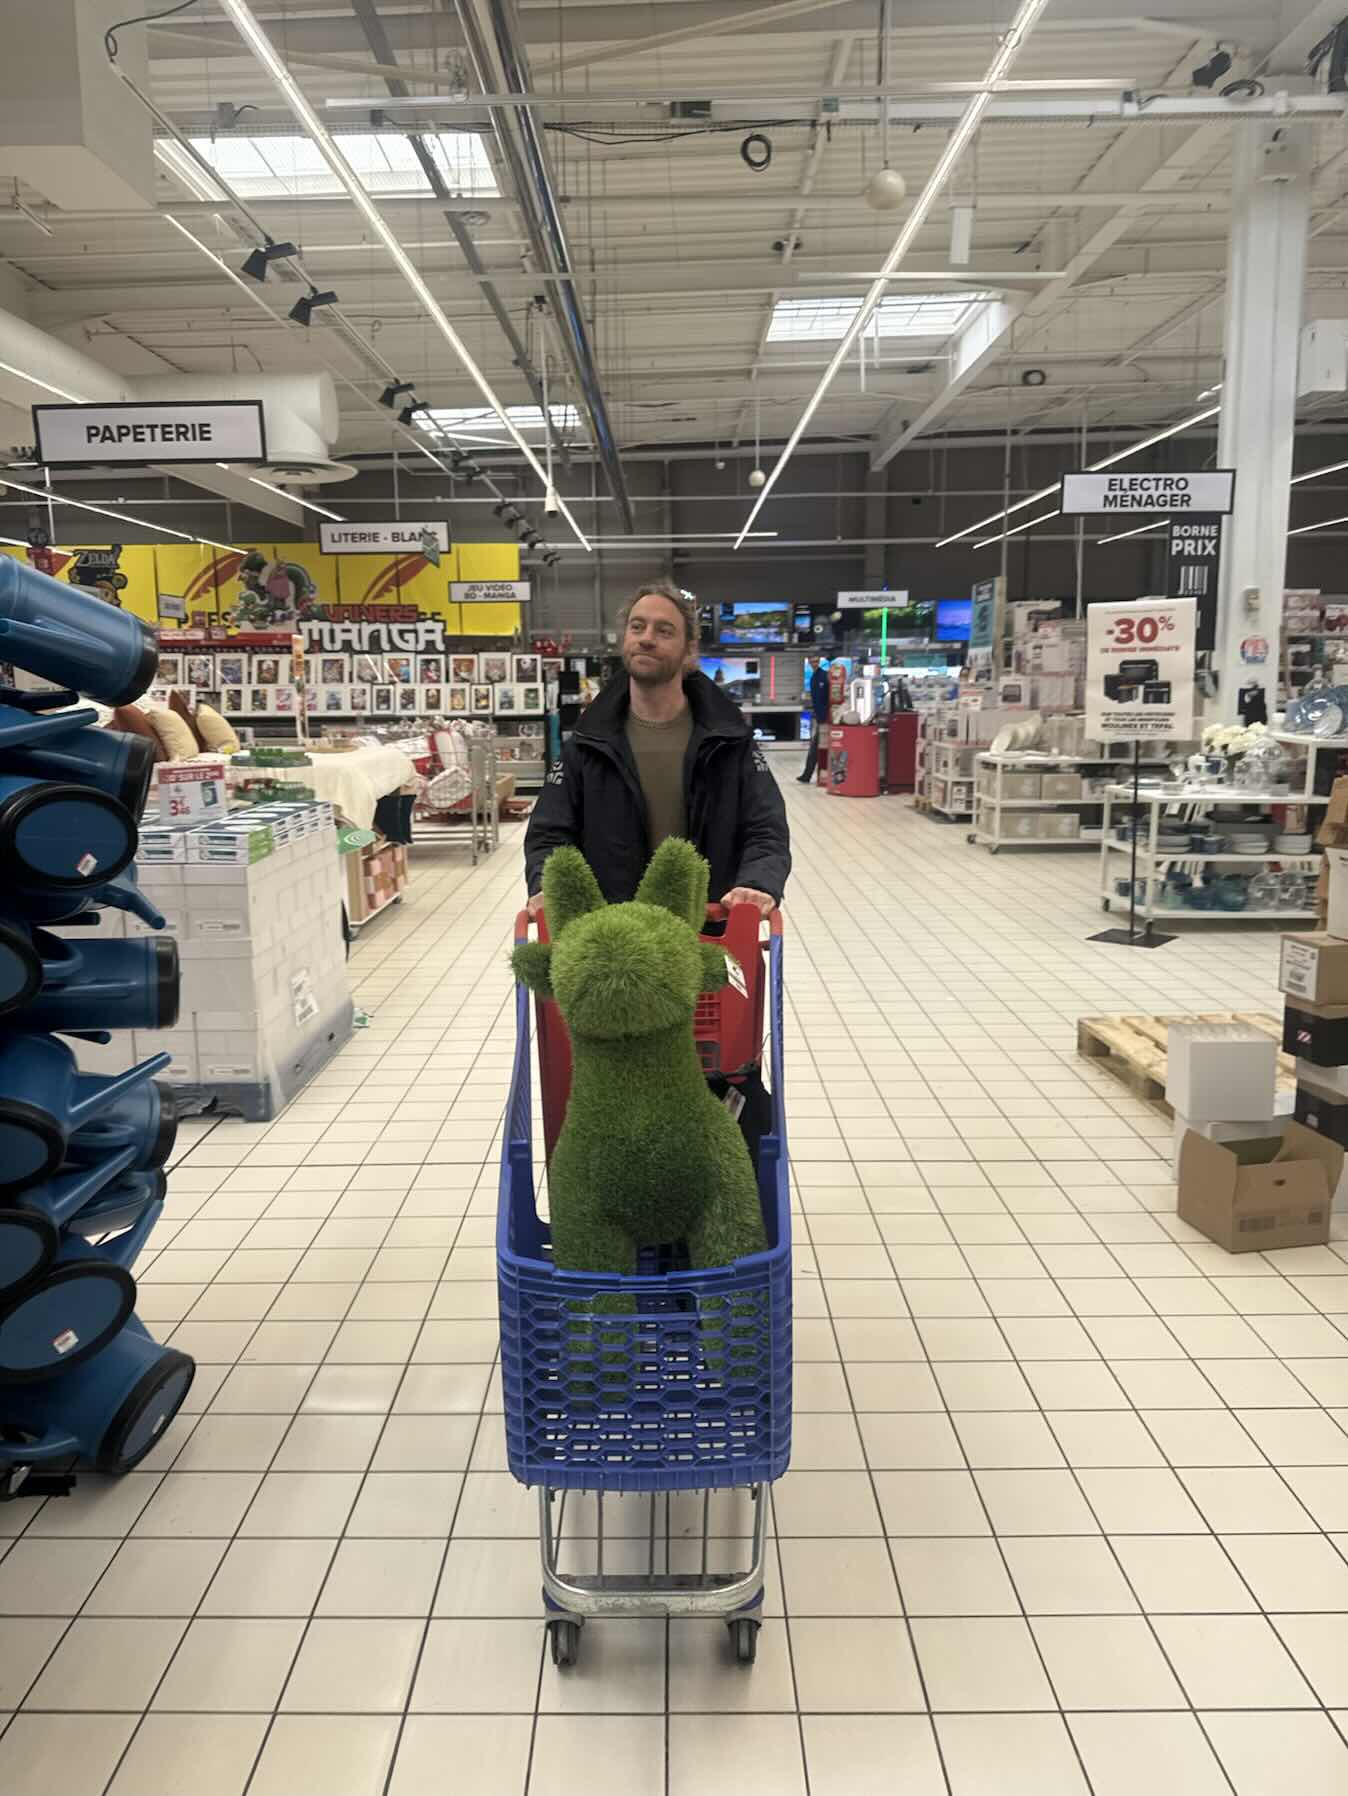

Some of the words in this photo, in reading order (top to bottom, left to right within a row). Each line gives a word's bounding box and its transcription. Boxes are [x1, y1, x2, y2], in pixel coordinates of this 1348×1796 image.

[86, 423, 212, 443] PAPETERIE
[1107, 477, 1189, 492] ELECTRO
[330, 532, 380, 544] LITERIE
[1172, 525, 1219, 537] BORNE
[1171, 539, 1217, 556] PRIX
[299, 620, 446, 652] MANGA
